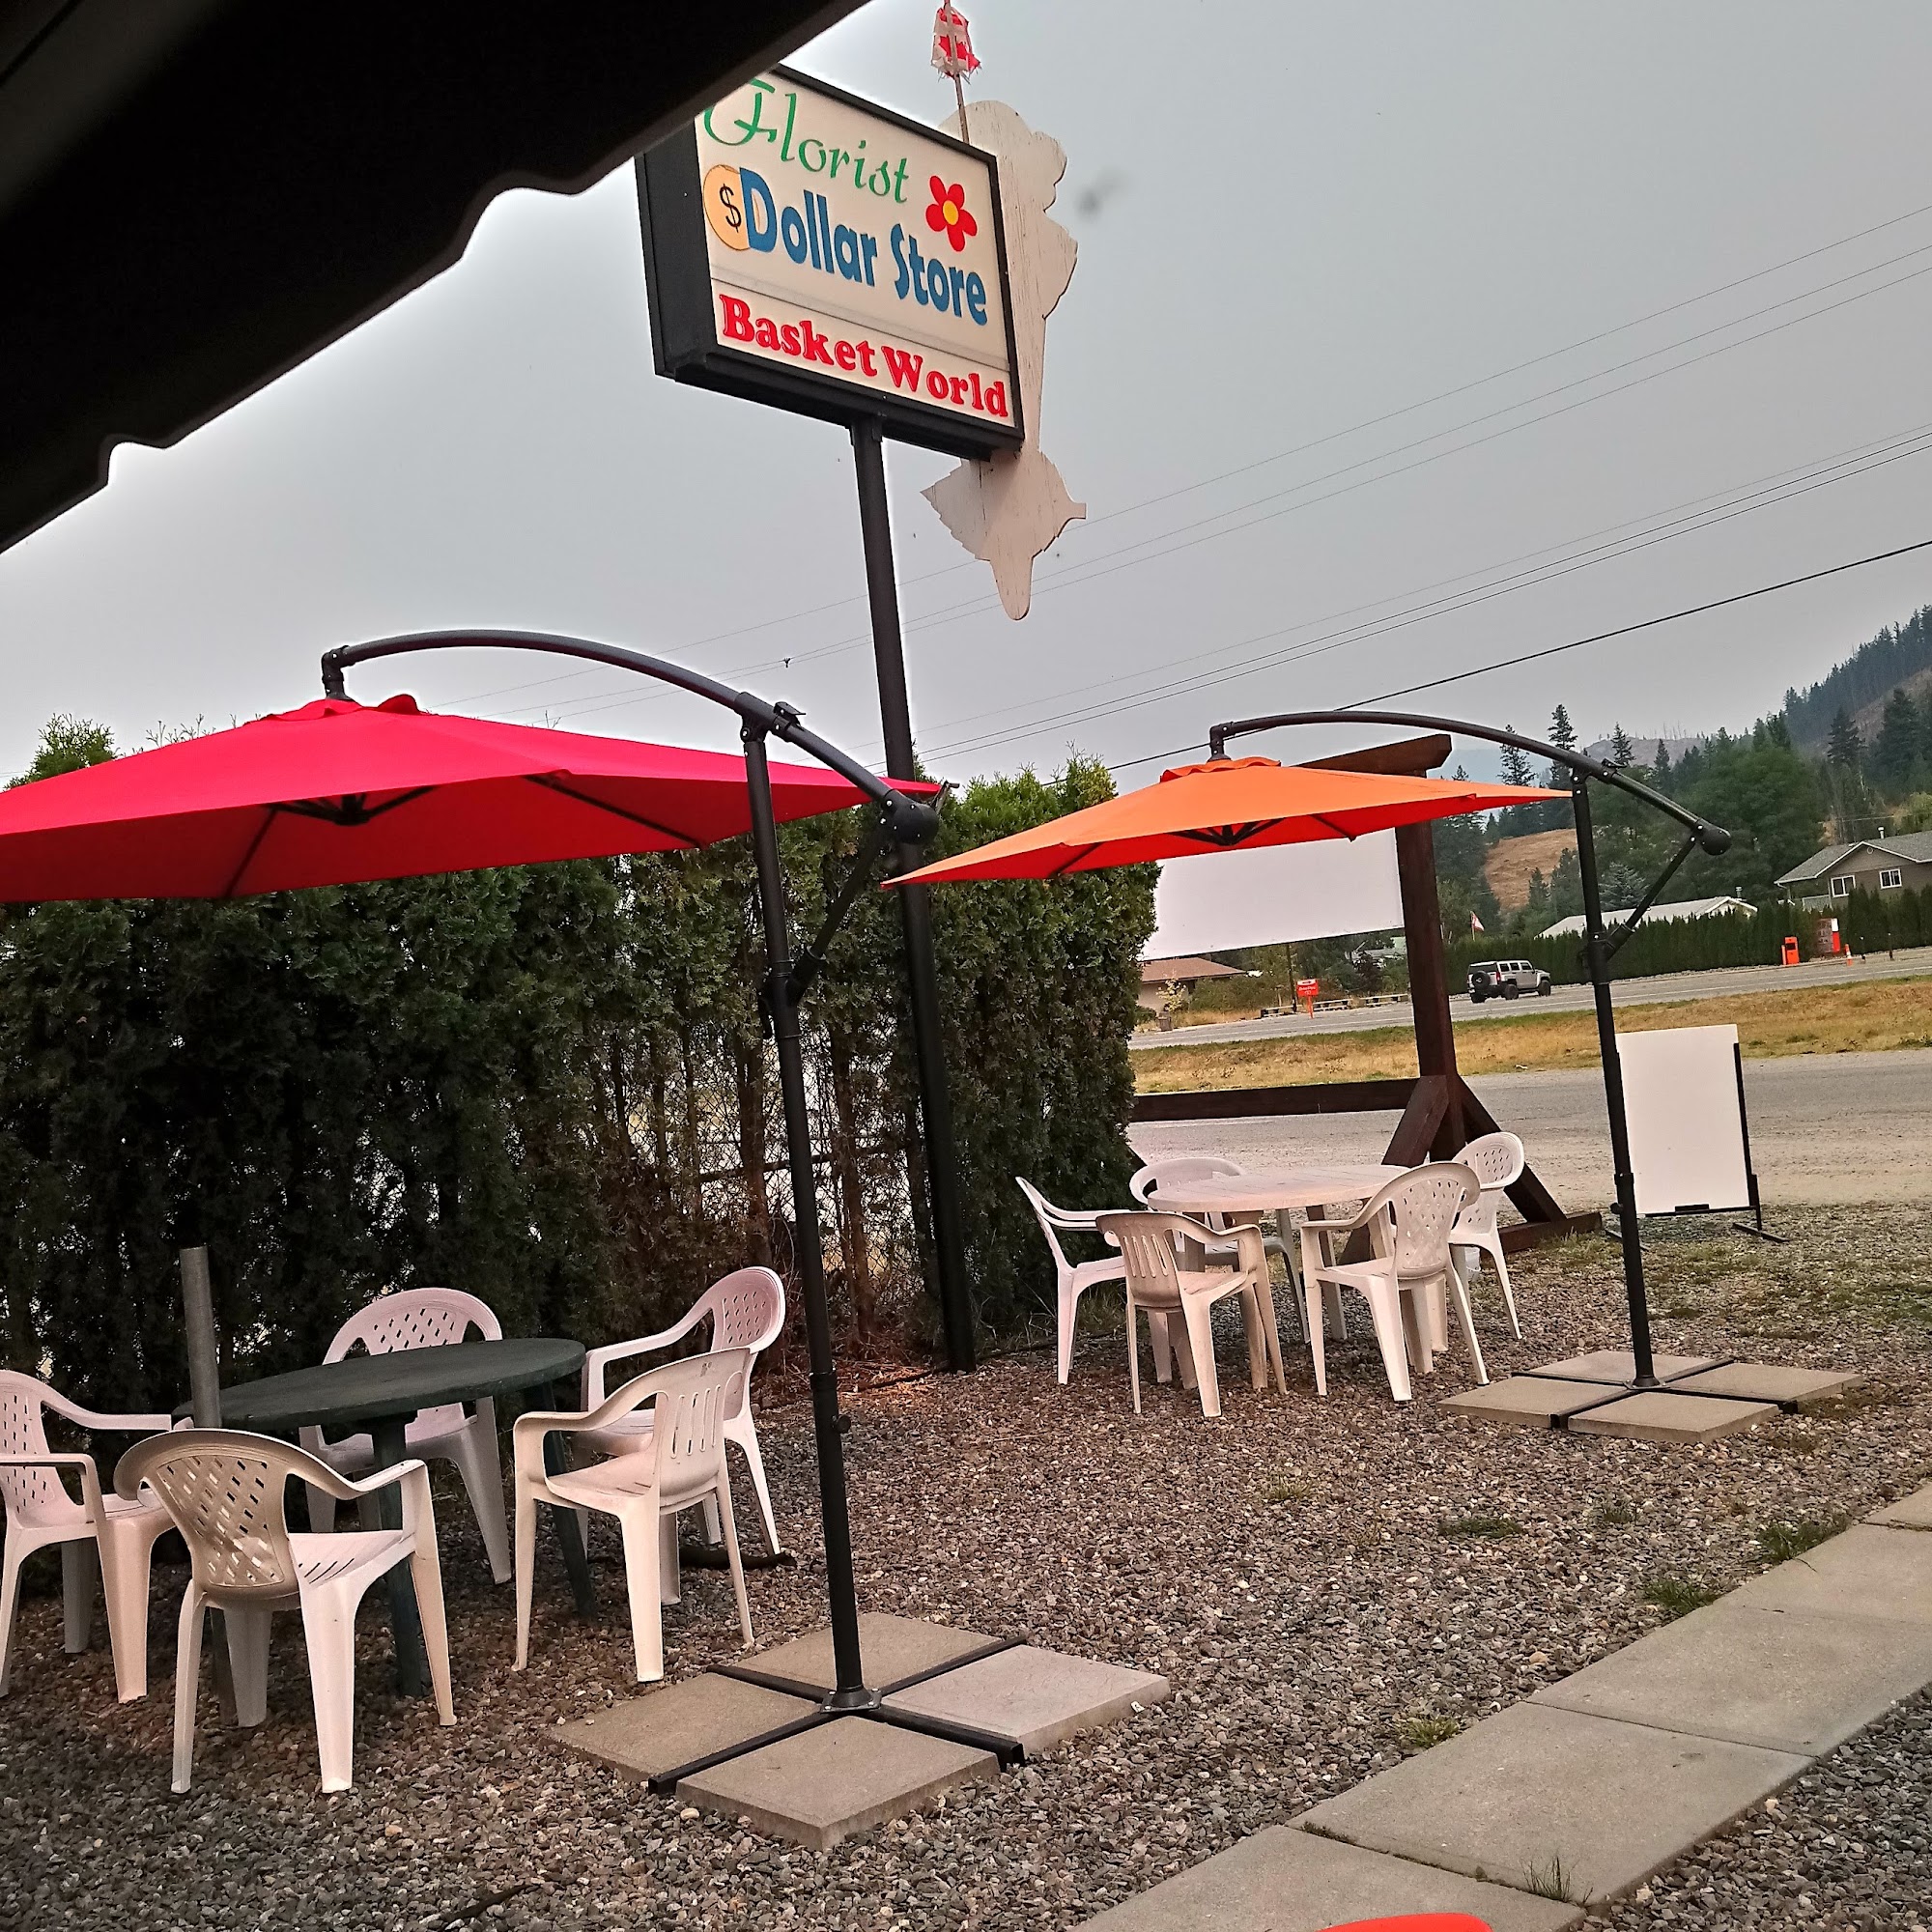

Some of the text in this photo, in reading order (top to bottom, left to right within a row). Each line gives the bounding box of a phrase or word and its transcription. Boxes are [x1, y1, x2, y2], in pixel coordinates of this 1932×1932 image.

[703, 77, 909, 204] Florist
[739, 166, 878, 287] Dollar
[890, 223, 987, 327] Store
[719, 294, 1009, 418] Basket World
